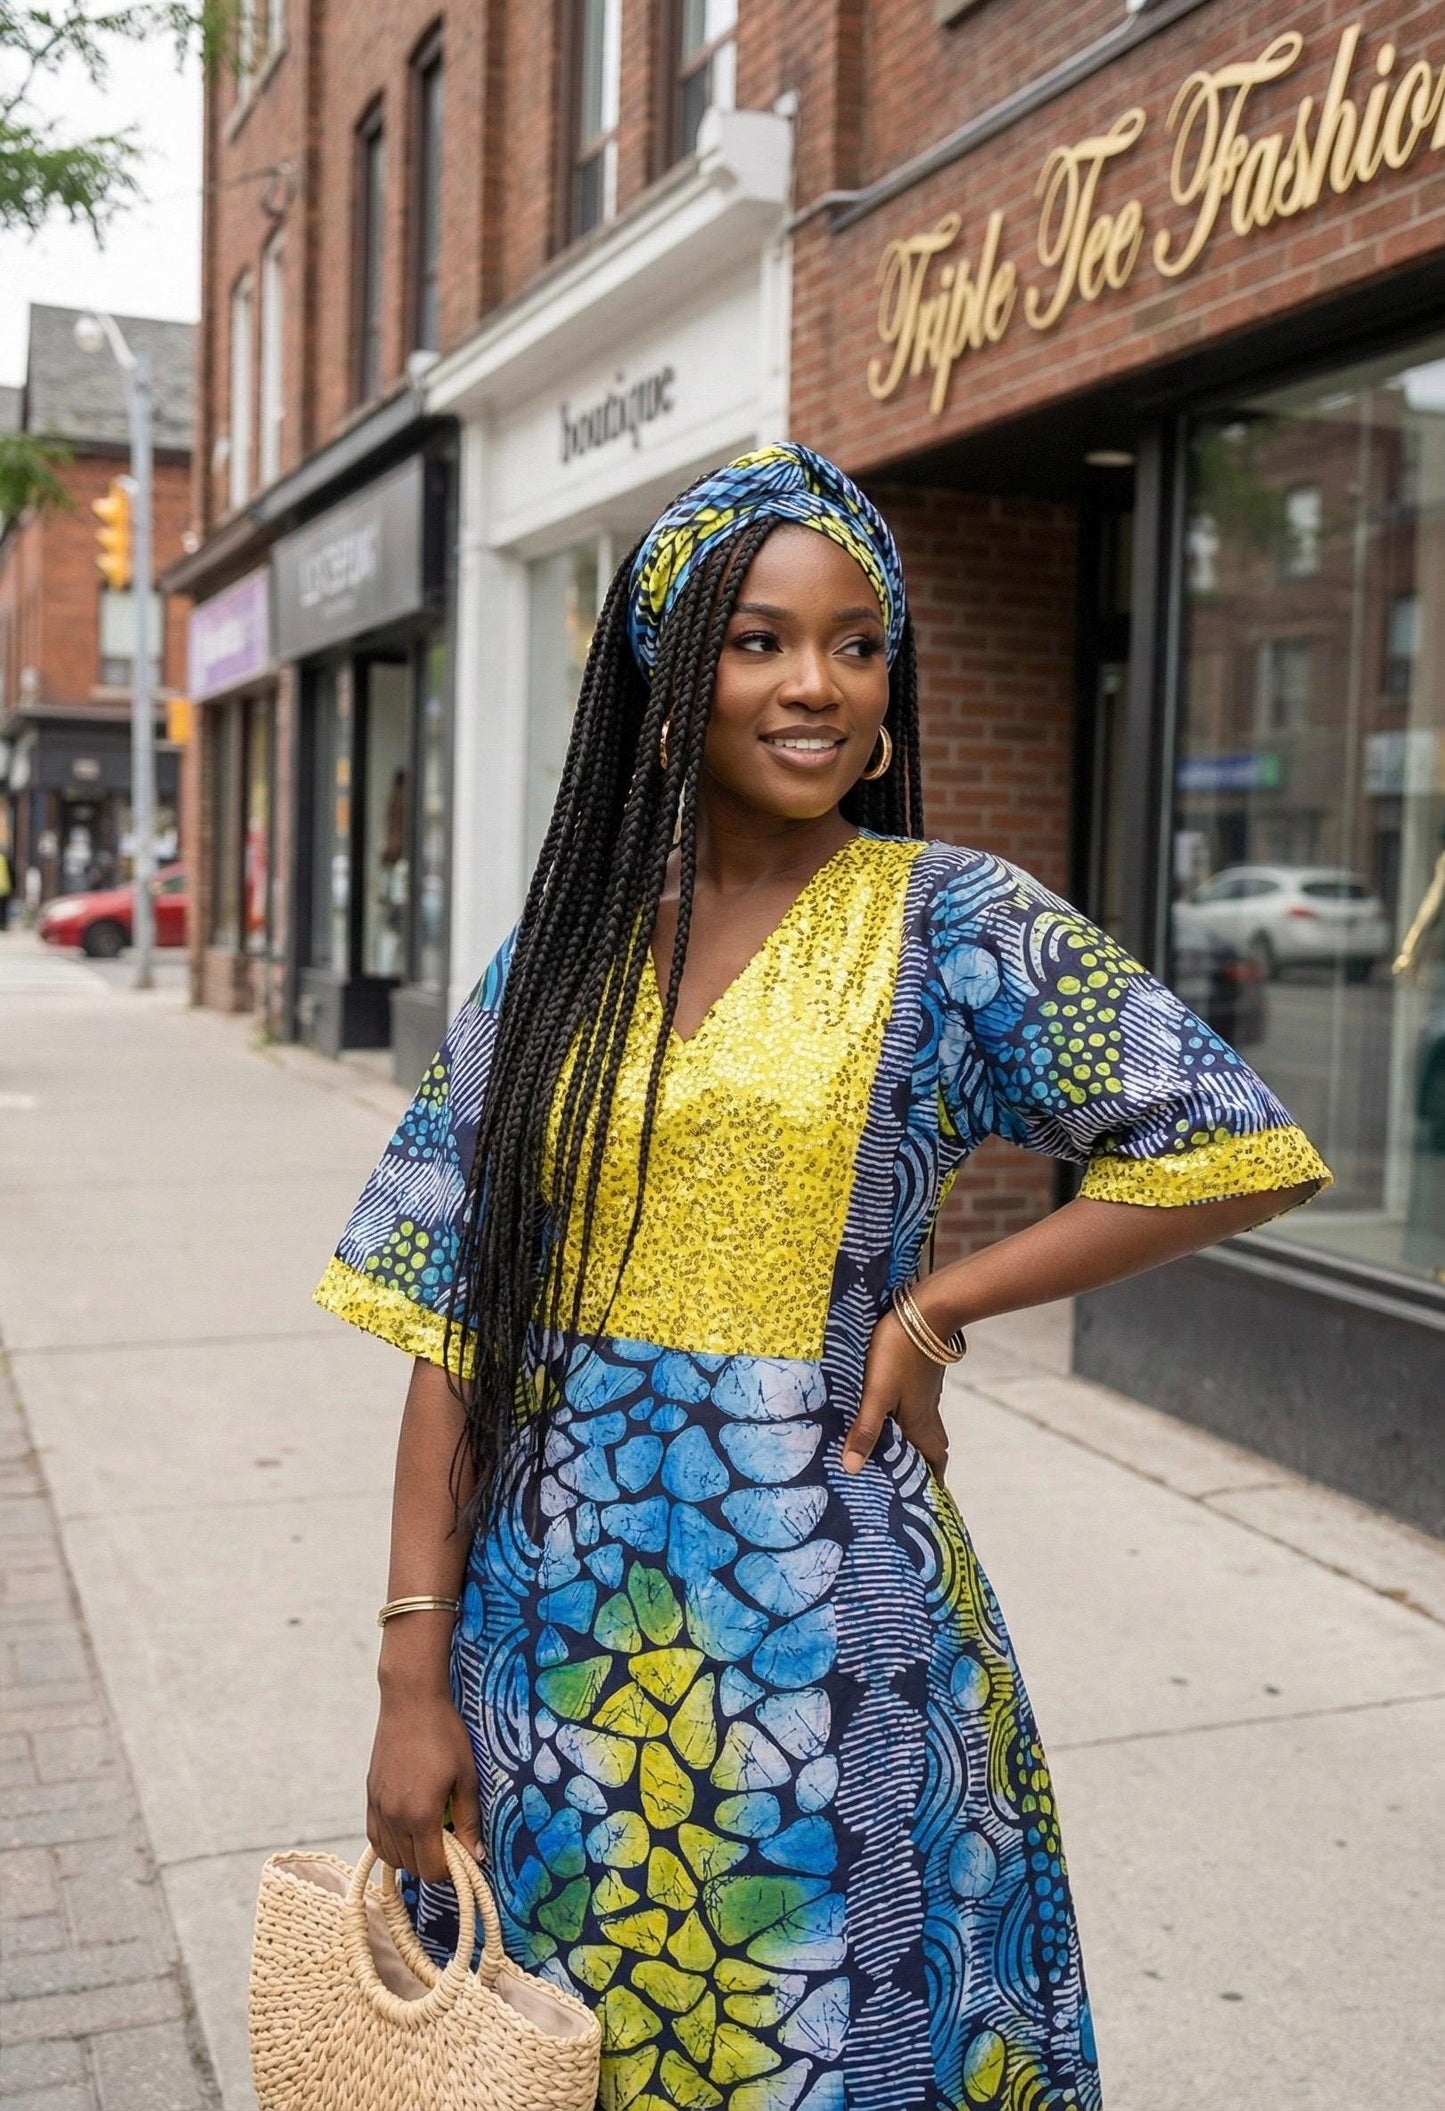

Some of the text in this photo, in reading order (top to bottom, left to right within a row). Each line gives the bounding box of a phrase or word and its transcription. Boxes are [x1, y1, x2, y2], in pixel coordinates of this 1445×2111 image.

[867, 209, 1017, 415] Triple
[1024, 107, 1147, 330] Tee
[560, 366, 674, 464] boutique
